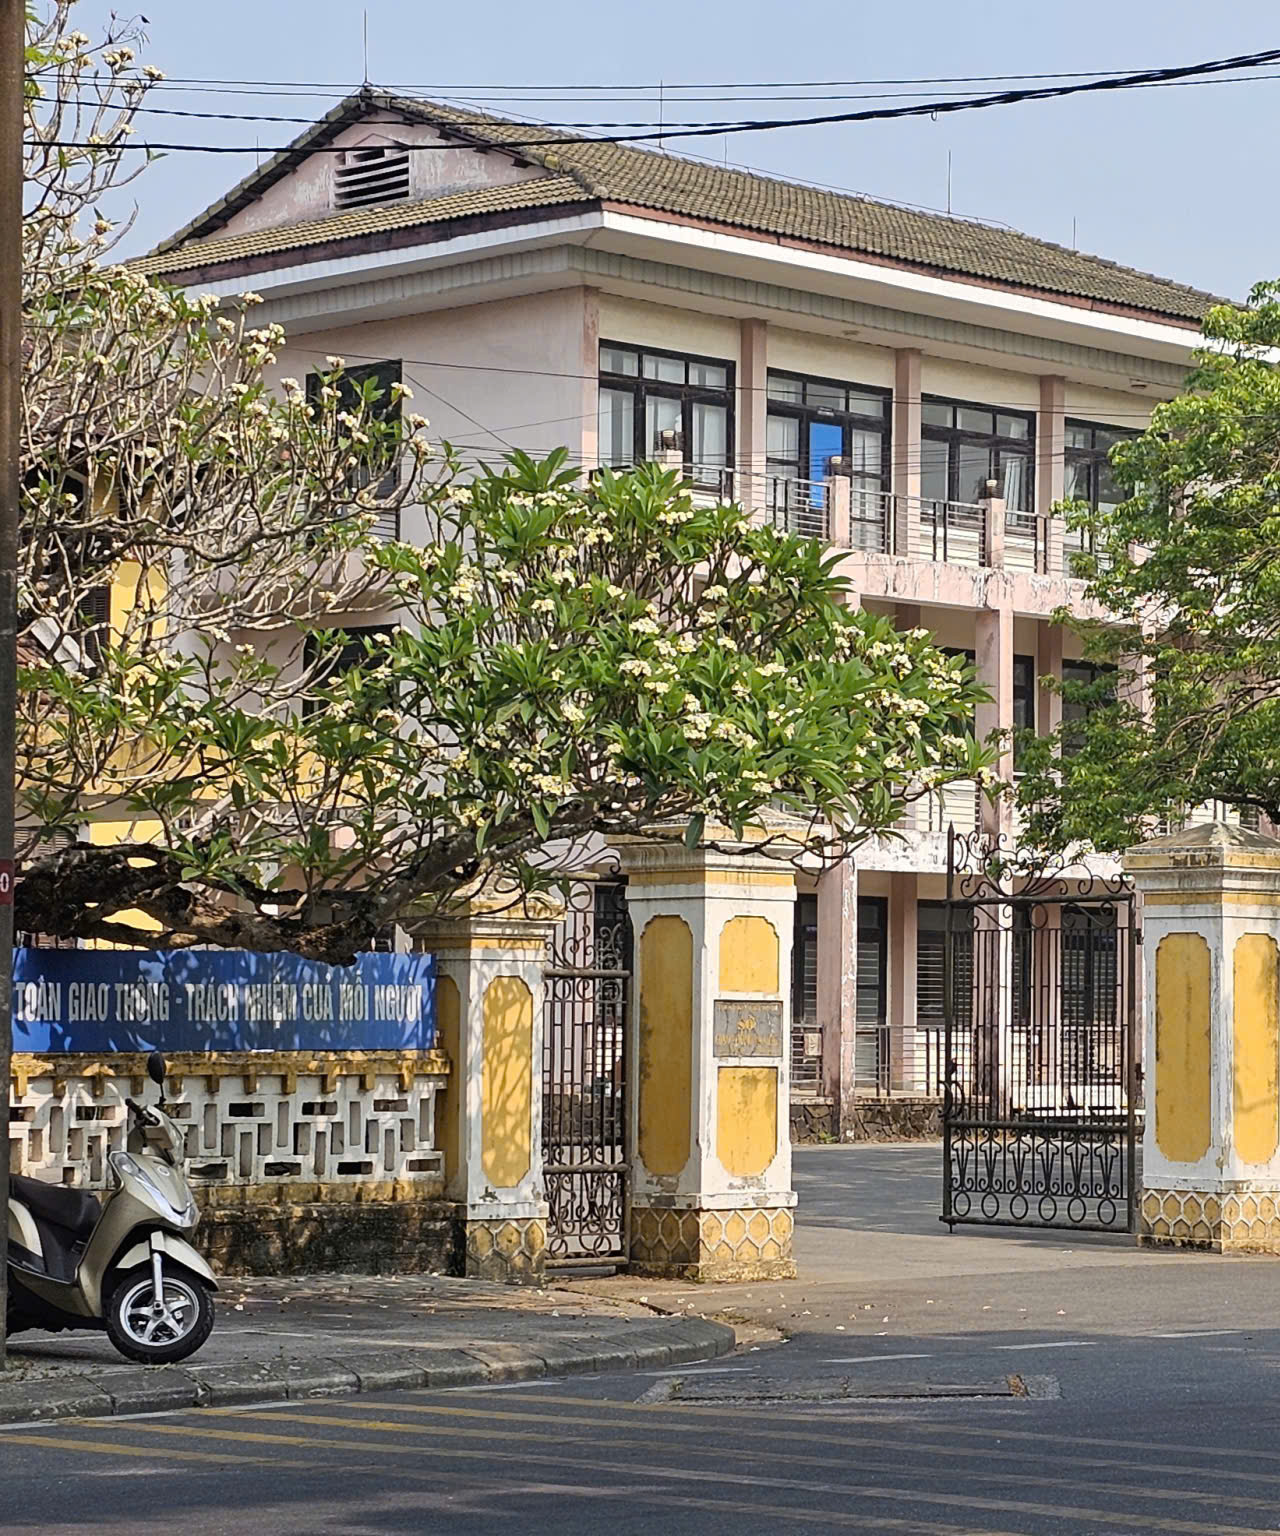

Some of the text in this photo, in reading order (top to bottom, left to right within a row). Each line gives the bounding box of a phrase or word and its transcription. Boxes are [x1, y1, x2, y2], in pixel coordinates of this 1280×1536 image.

[16, 975, 61, 1021] TOÀN
[69, 982, 108, 1021] GIAO
[114, 975, 170, 1021] THÔNG
[185, 976, 239, 1021] TRÁCH
[245, 972, 297, 1029] NHIỆM
[339, 970, 369, 1021] MỖI
[374, 976, 422, 1021] NGƯỜI
